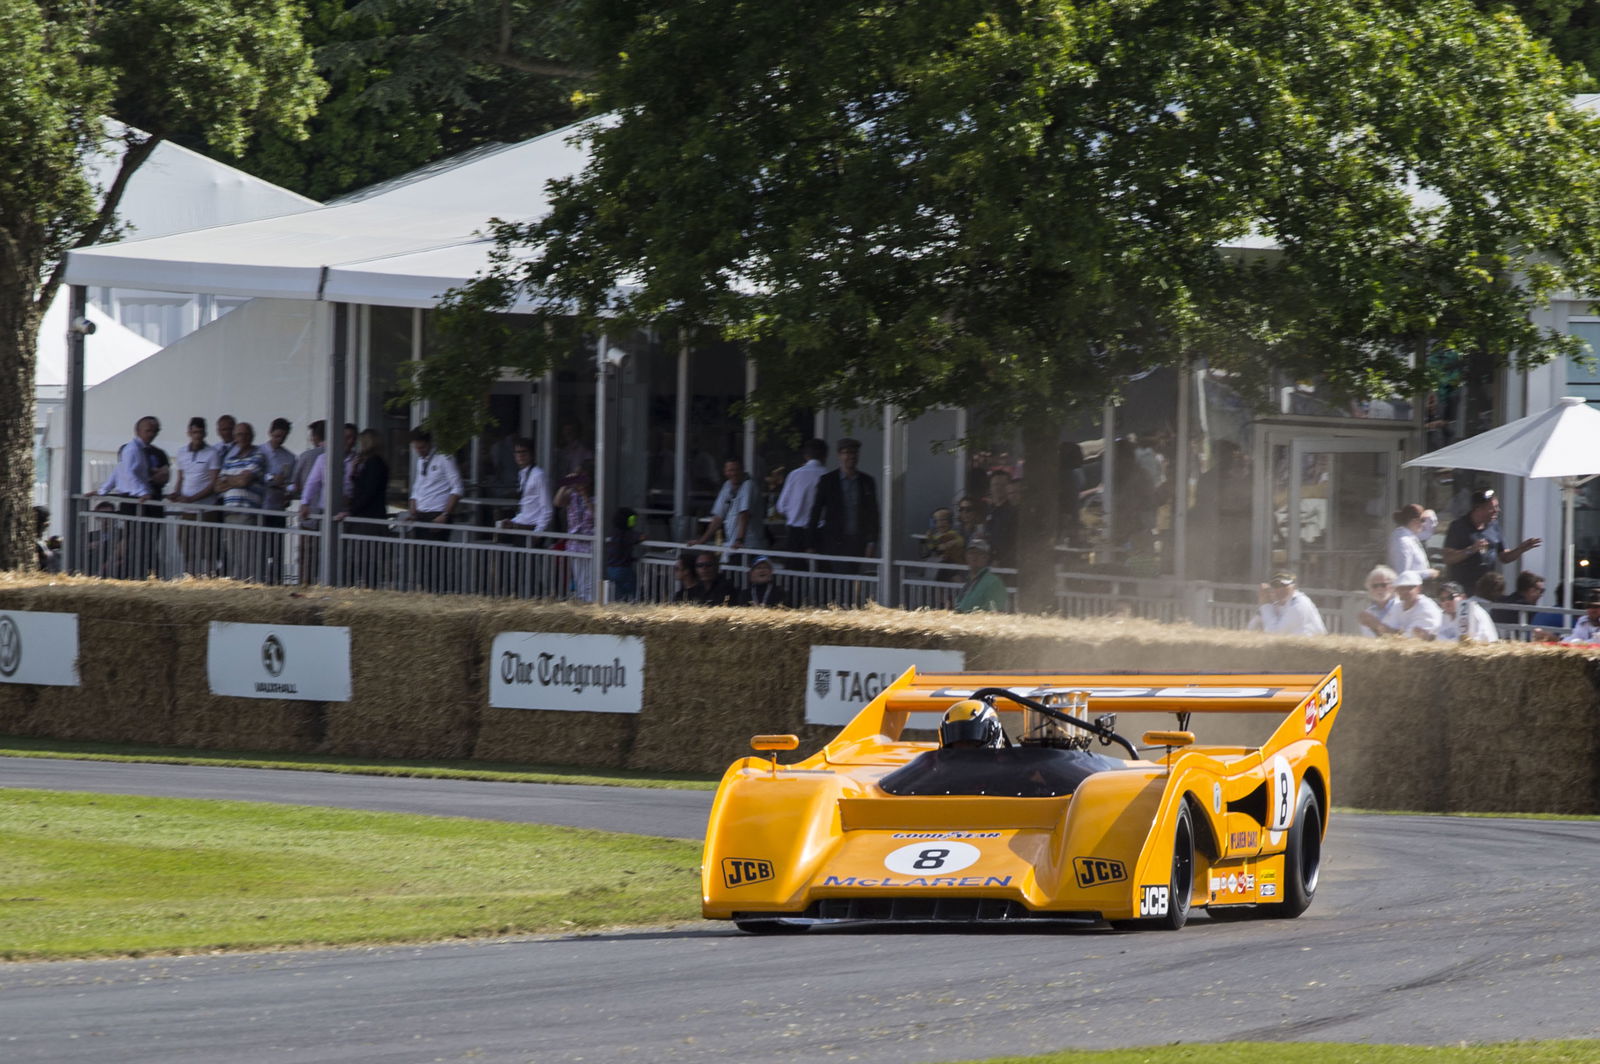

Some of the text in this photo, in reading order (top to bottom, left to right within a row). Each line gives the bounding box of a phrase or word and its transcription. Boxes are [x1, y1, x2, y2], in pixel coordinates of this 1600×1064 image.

[501, 650, 626, 694] The Telegraph
[255, 682, 298, 693] VAUXHALL
[1280, 772, 1288, 825] 8
[912, 849, 951, 870] 8
[729, 861, 770, 884] JCB
[823, 875, 1012, 887] McLAREN
[1081, 860, 1122, 884] JCB
[1140, 887, 1168, 915] JCB
